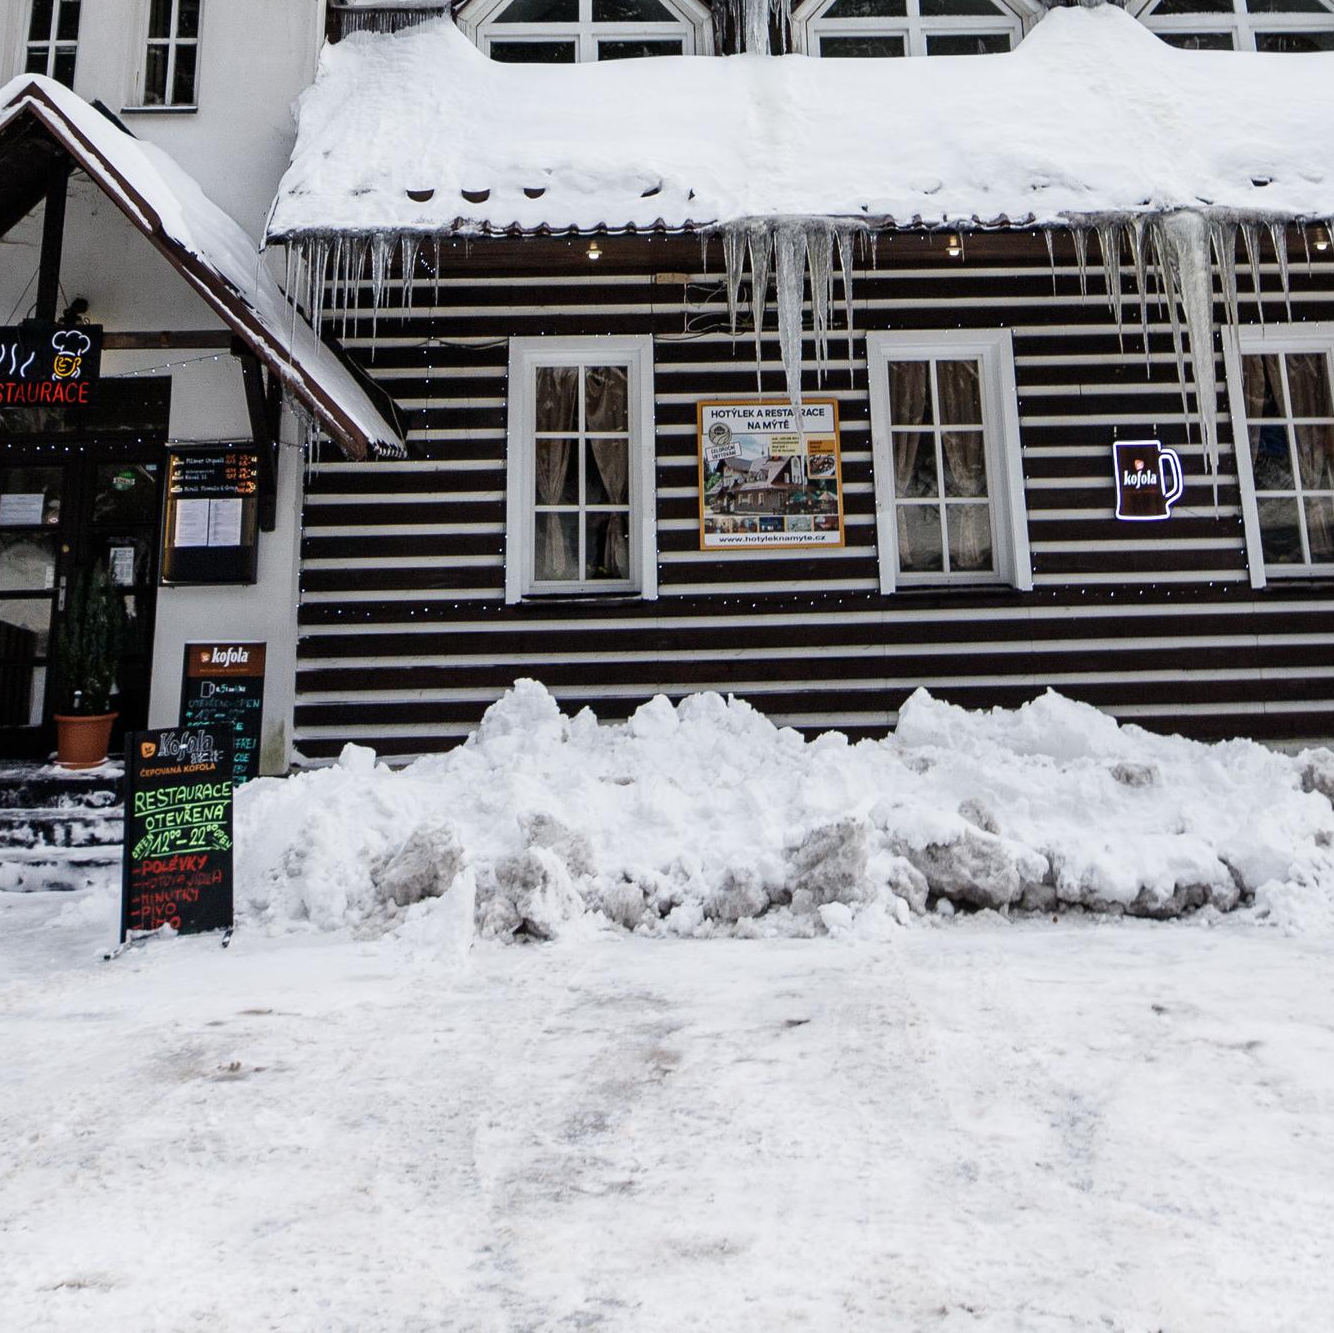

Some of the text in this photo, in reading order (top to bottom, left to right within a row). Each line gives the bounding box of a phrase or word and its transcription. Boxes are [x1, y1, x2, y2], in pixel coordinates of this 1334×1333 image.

[711, 407, 825, 418] HOTÝLEK A RESTARACE
[748, 419, 790, 430] NA MÝTĚ
[1124, 470, 1157, 489] kofola
[719, 534, 826, 543] www.hotyleknamyte.cz
[211, 647, 249, 667] kofola
[140, 763, 216, 776] ČEPOVANÁ KOFOLA
[134, 781, 232, 812] RESTAURACE
